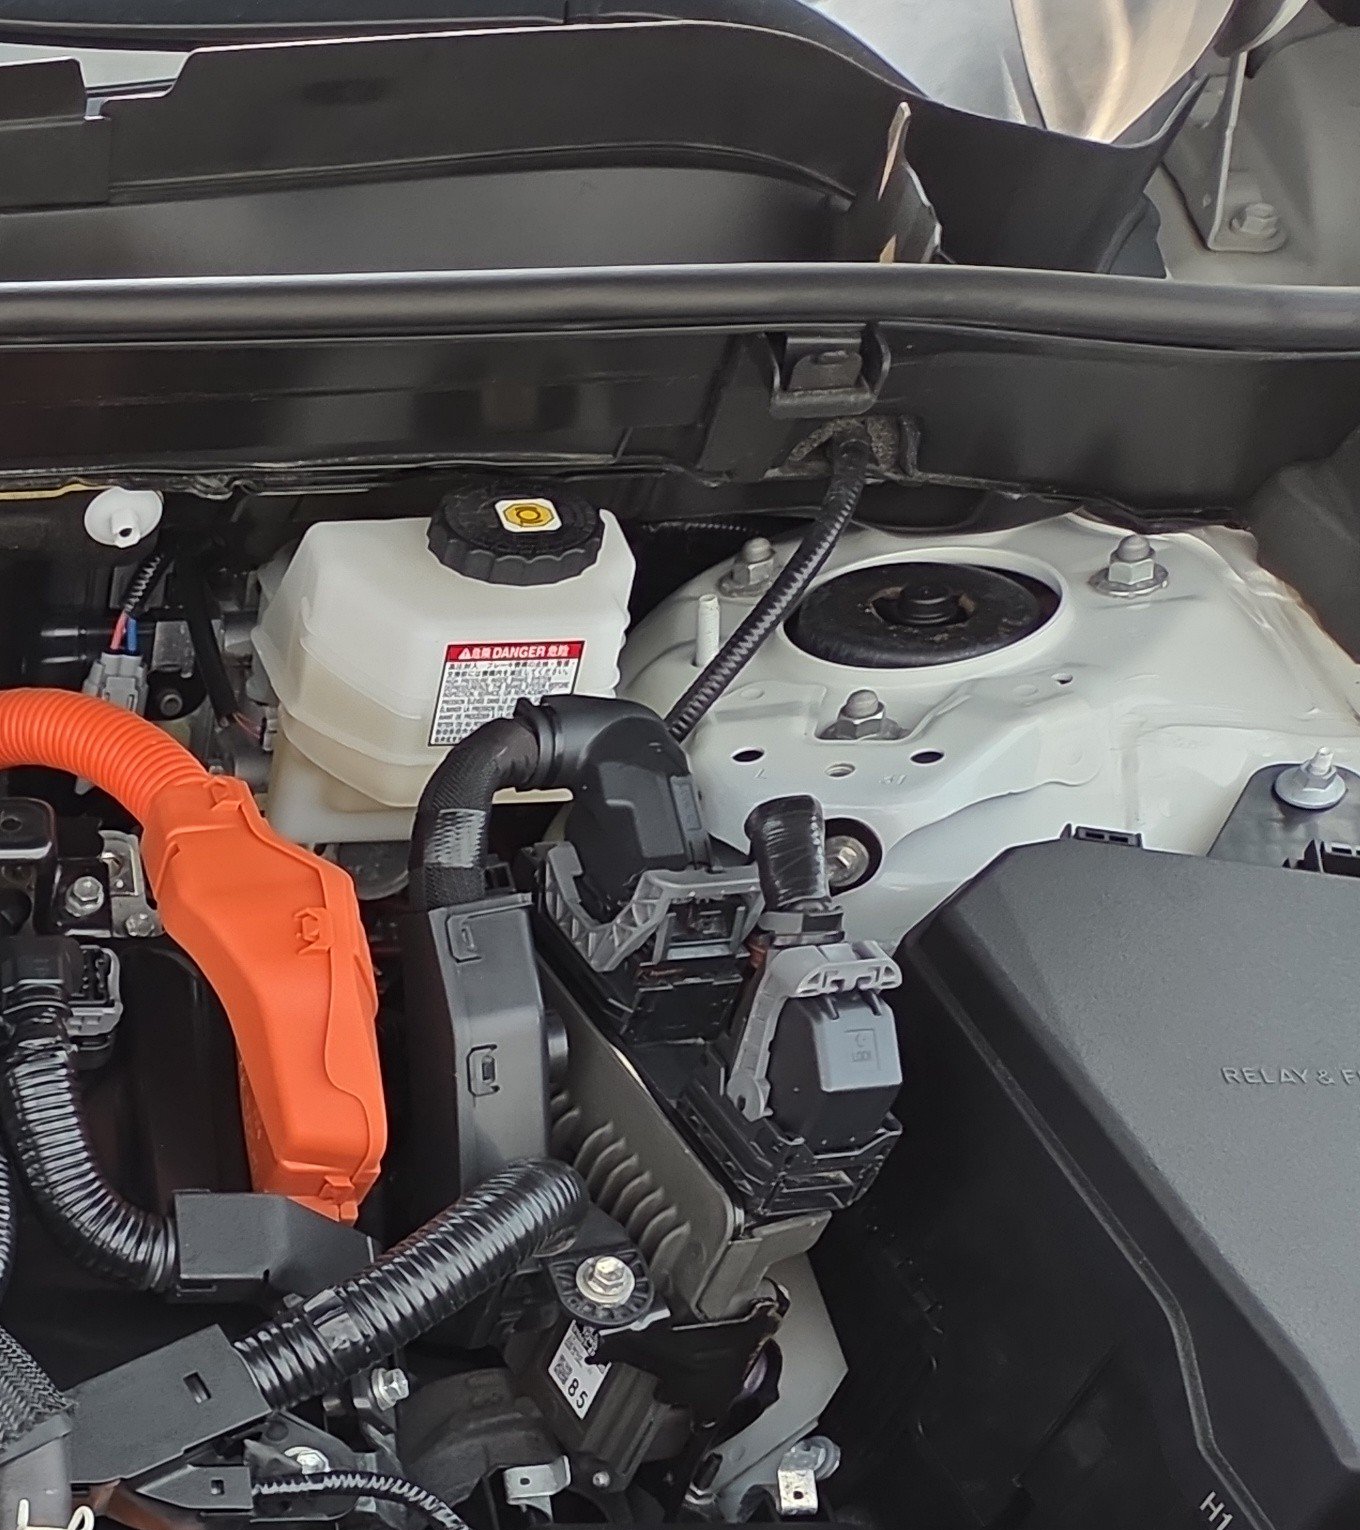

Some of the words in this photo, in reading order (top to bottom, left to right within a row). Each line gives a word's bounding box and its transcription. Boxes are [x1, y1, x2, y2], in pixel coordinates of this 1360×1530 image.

[492, 645, 546, 659] DANGER
[1221, 1066, 1308, 1085] RELAY
[1316, 1068, 1336, 1086] &
